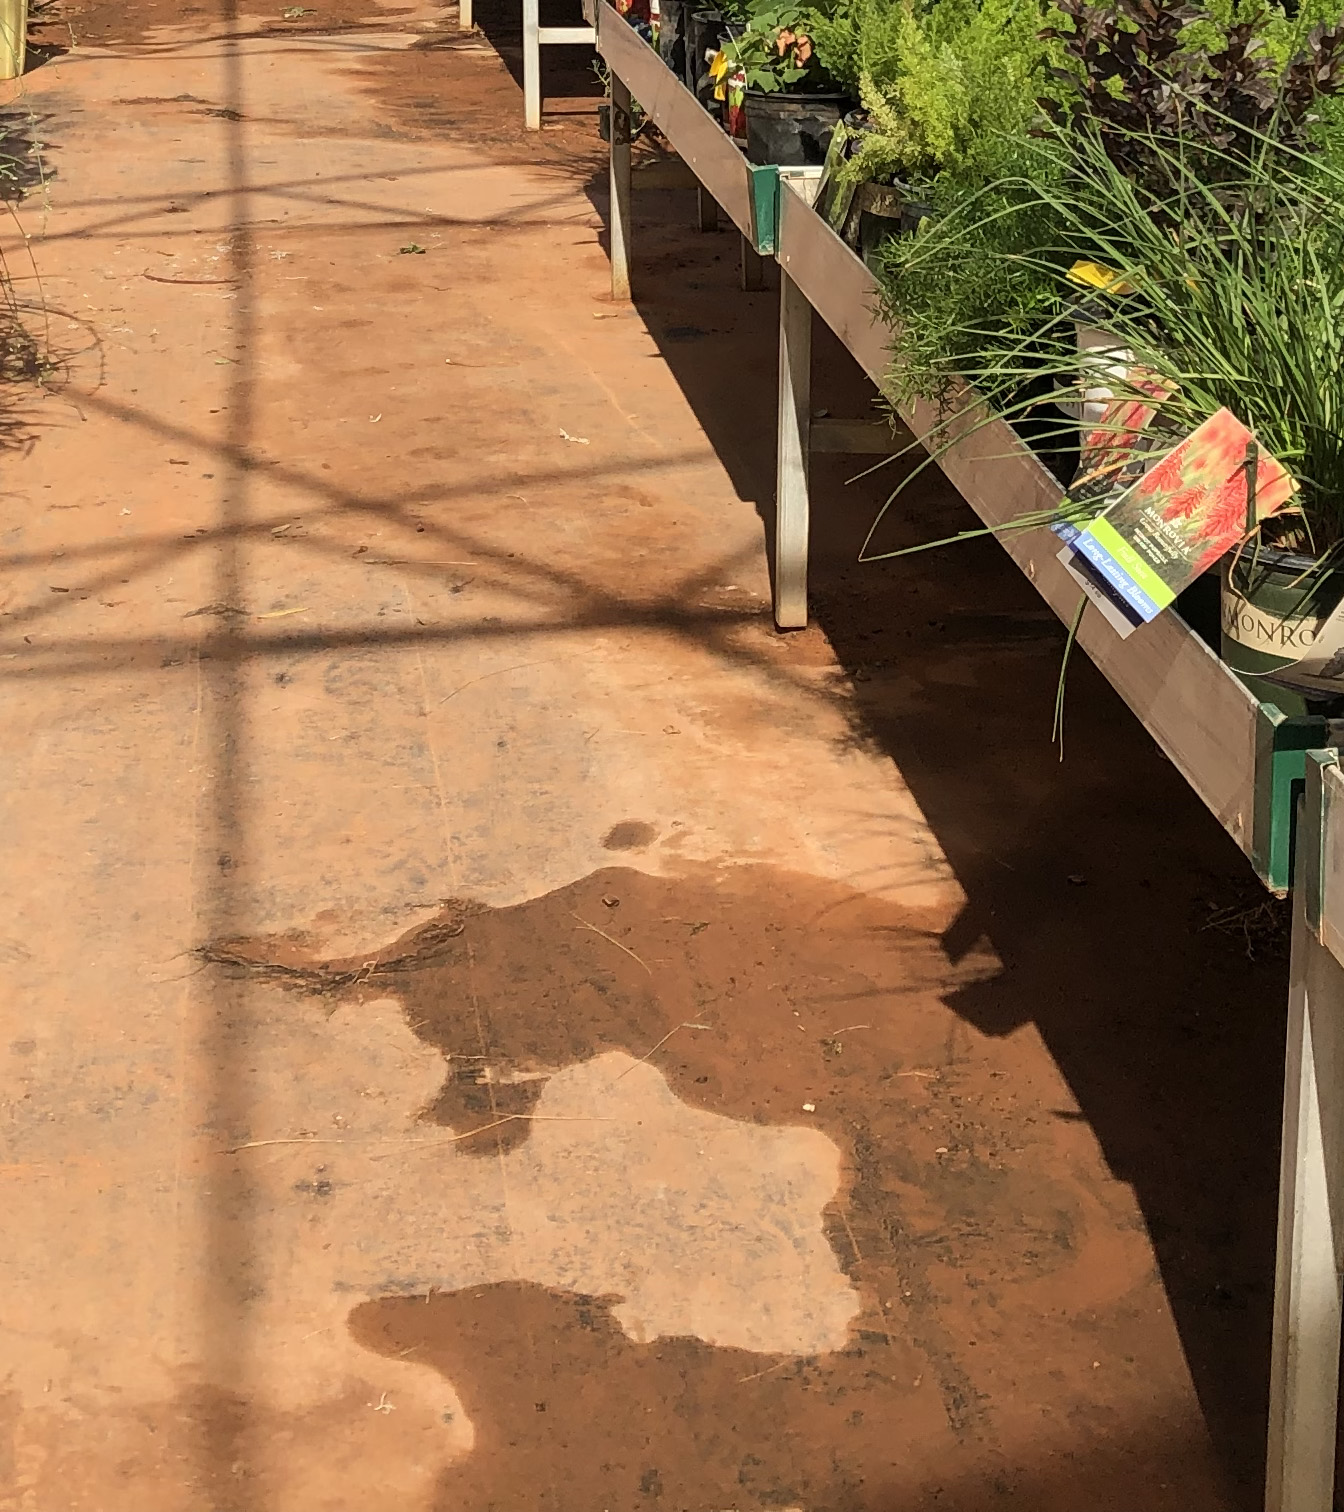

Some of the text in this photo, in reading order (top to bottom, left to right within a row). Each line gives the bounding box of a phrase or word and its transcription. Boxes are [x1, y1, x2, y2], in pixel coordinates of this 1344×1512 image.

[1139, 517, 1179, 560] Grow Beautifully
[1144, 506, 1191, 556] MONROVIA
[1082, 538, 1130, 589] Long-Lasting
[1128, 583, 1154, 615] Blooms
[1117, 545, 1148, 580] Full Sun
